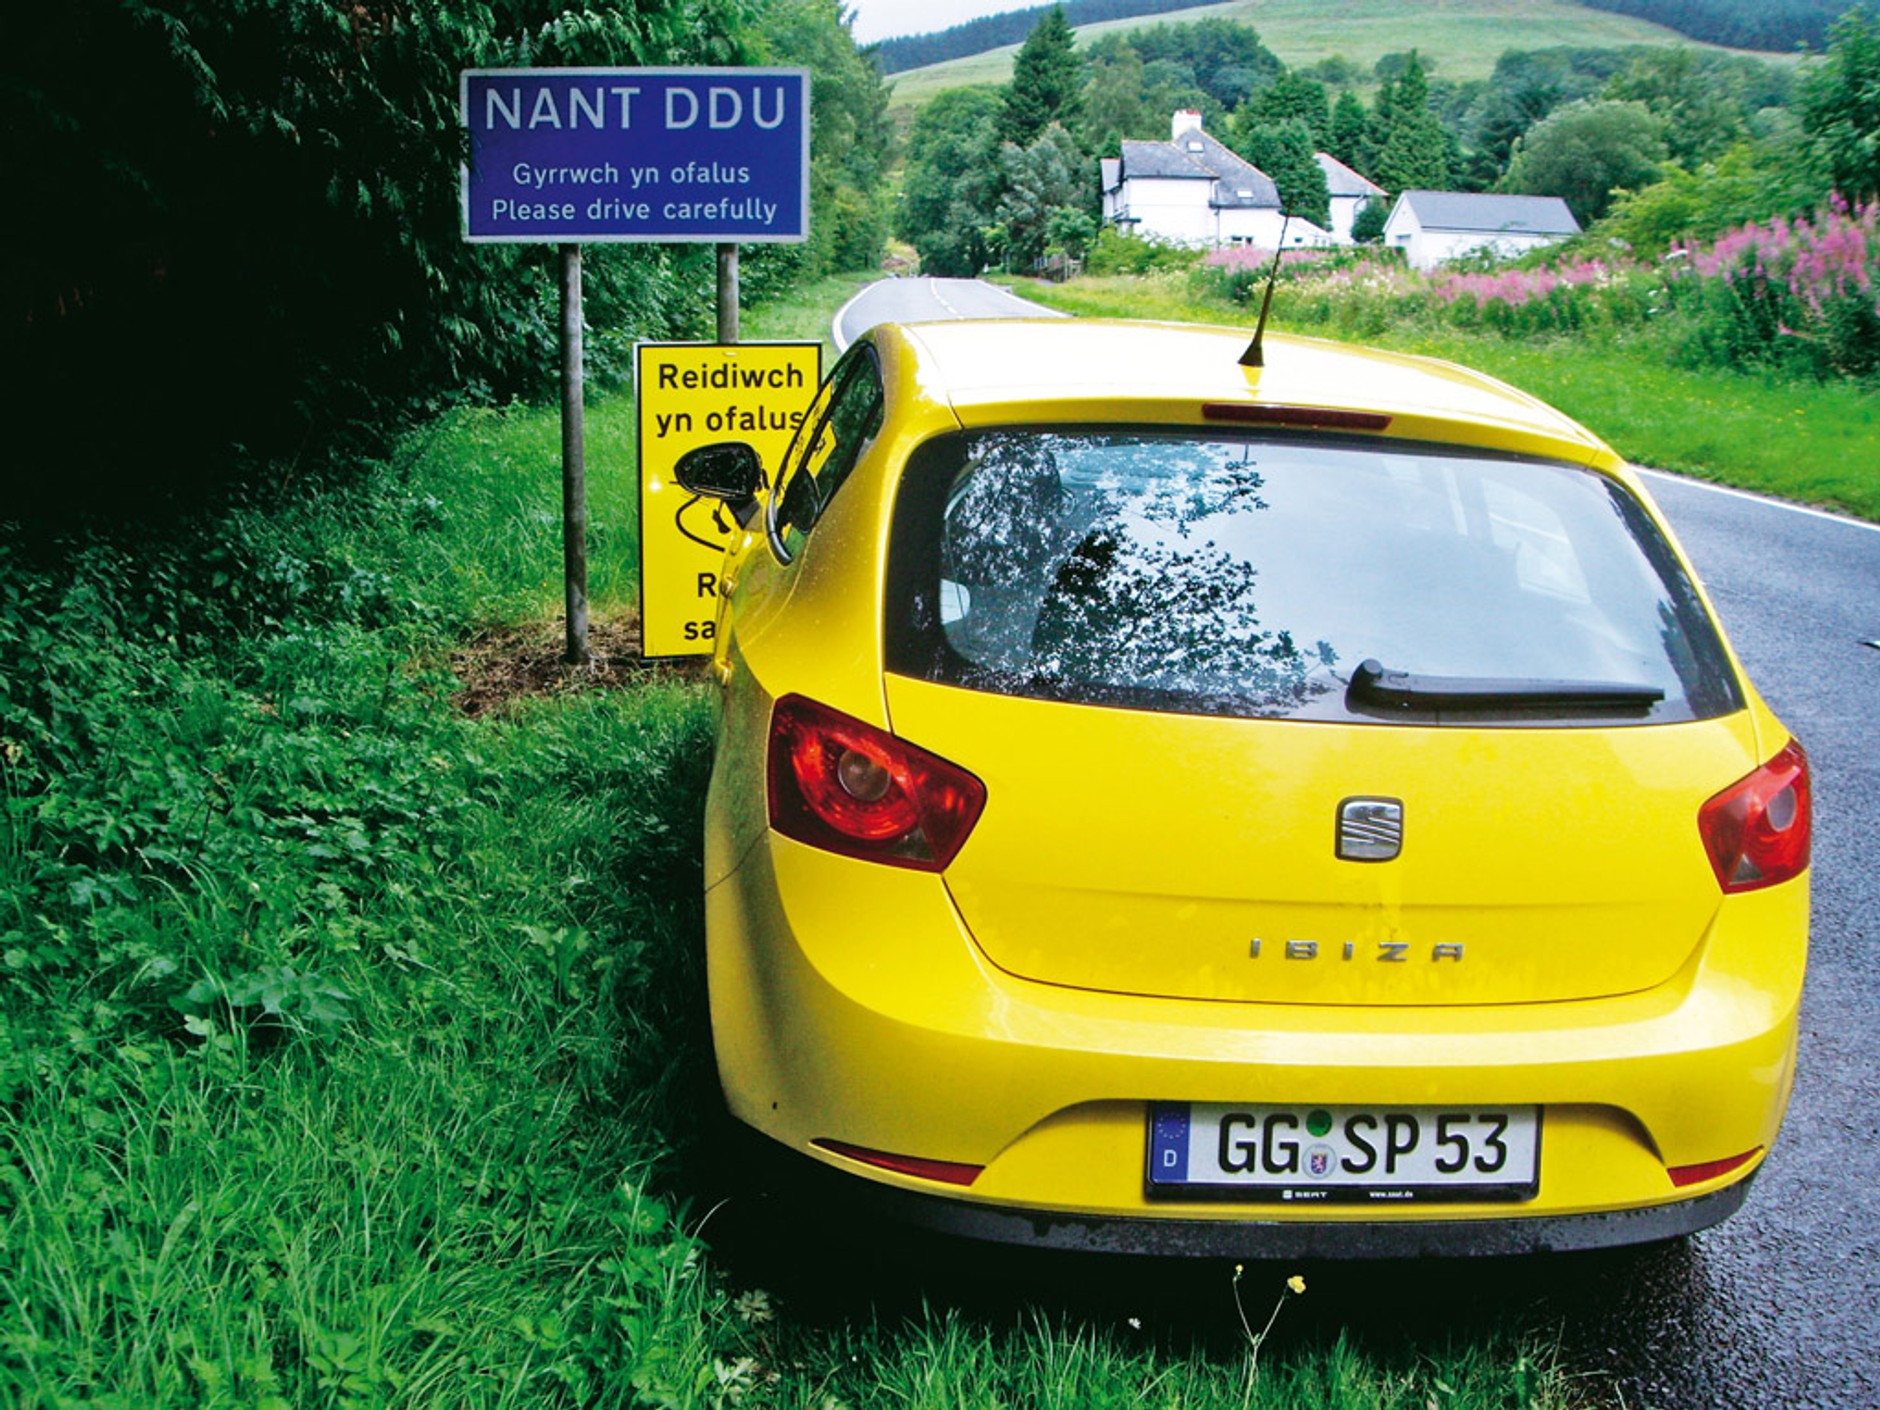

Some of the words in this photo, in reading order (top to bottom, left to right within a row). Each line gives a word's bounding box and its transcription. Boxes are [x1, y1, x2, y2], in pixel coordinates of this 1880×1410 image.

[486, 87, 641, 129] NANT
[665, 87, 785, 129] DDU
[513, 162, 619, 189] Gyrrwch
[631, 171, 659, 188] yn
[670, 162, 750, 183] ofalus
[491, 199, 576, 220] Please
[587, 198, 650, 220] drive
[663, 198, 777, 225] carefully
[659, 364, 804, 389] Reidiwch
[656, 413, 692, 438] yn
[706, 405, 803, 432] ofalus
[1250, 938, 1464, 962] IBIZA
[1218, 1113, 1299, 1173] GG
[1341, 1113, 1419, 1174] SP
[1435, 1113, 1508, 1173] 53
[1164, 1149, 1177, 1166] D
[1294, 1191, 1328, 1199] SEAT
